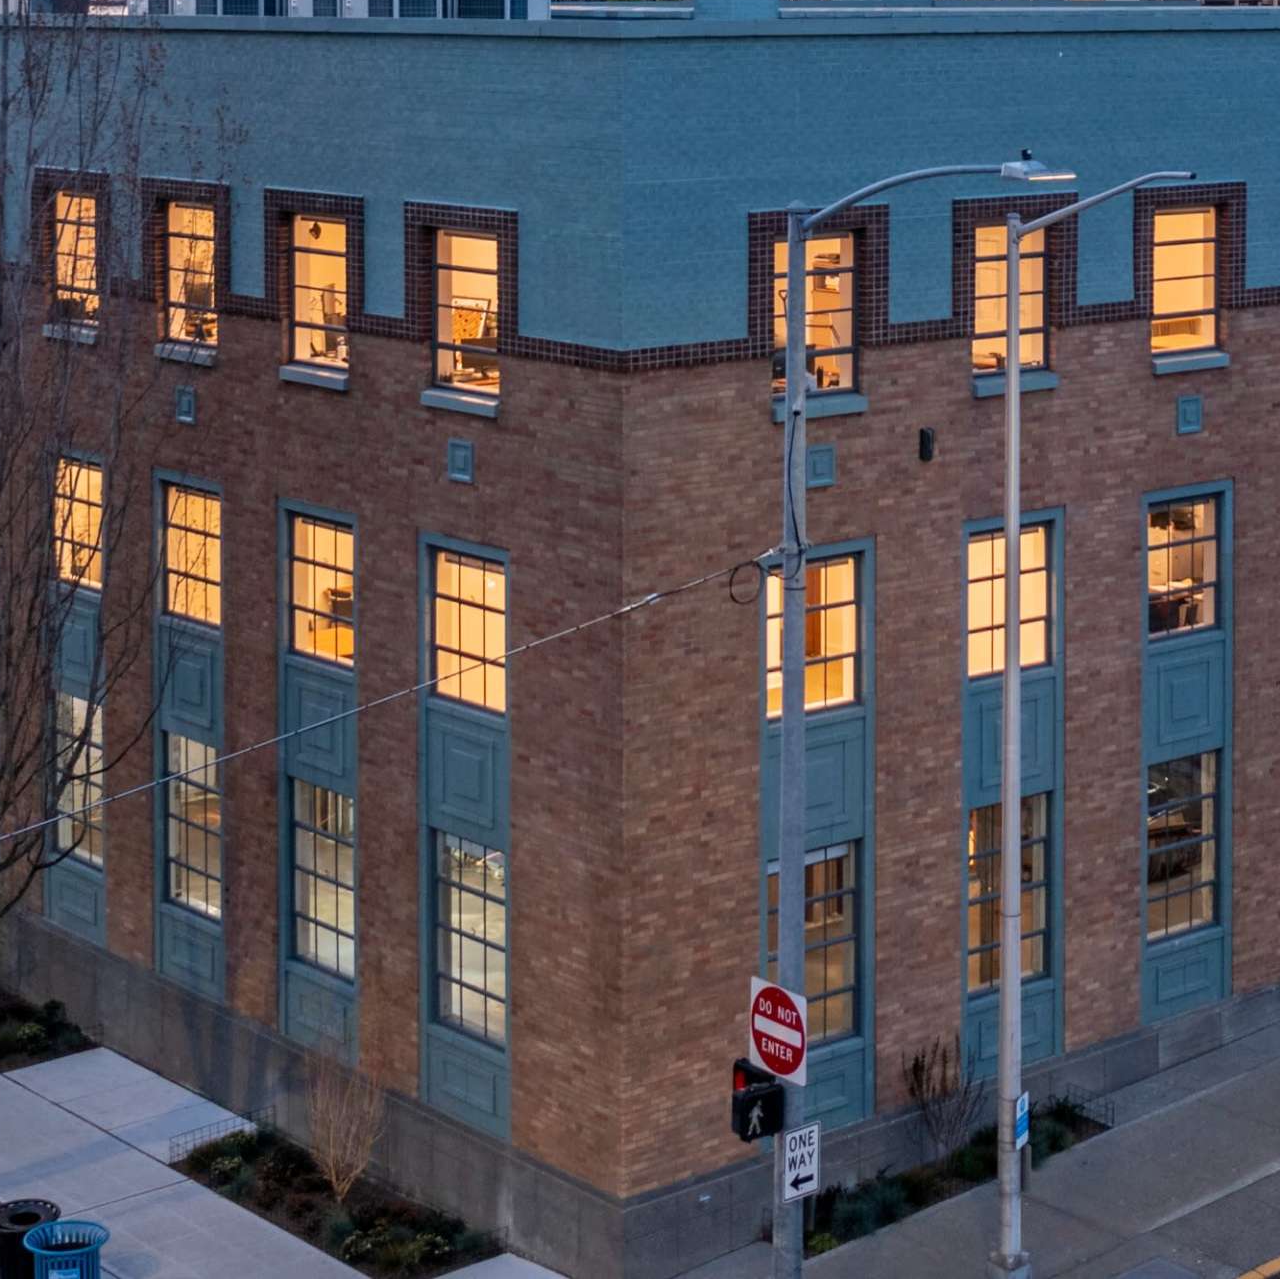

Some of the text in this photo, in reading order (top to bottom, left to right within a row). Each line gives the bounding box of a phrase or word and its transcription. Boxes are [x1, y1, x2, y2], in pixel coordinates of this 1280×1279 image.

[759, 997, 797, 1025] DO NOT
[761, 1038, 793, 1063] ENTER
[789, 1130, 815, 1152] ONE
[788, 1148, 816, 1172] WAY
